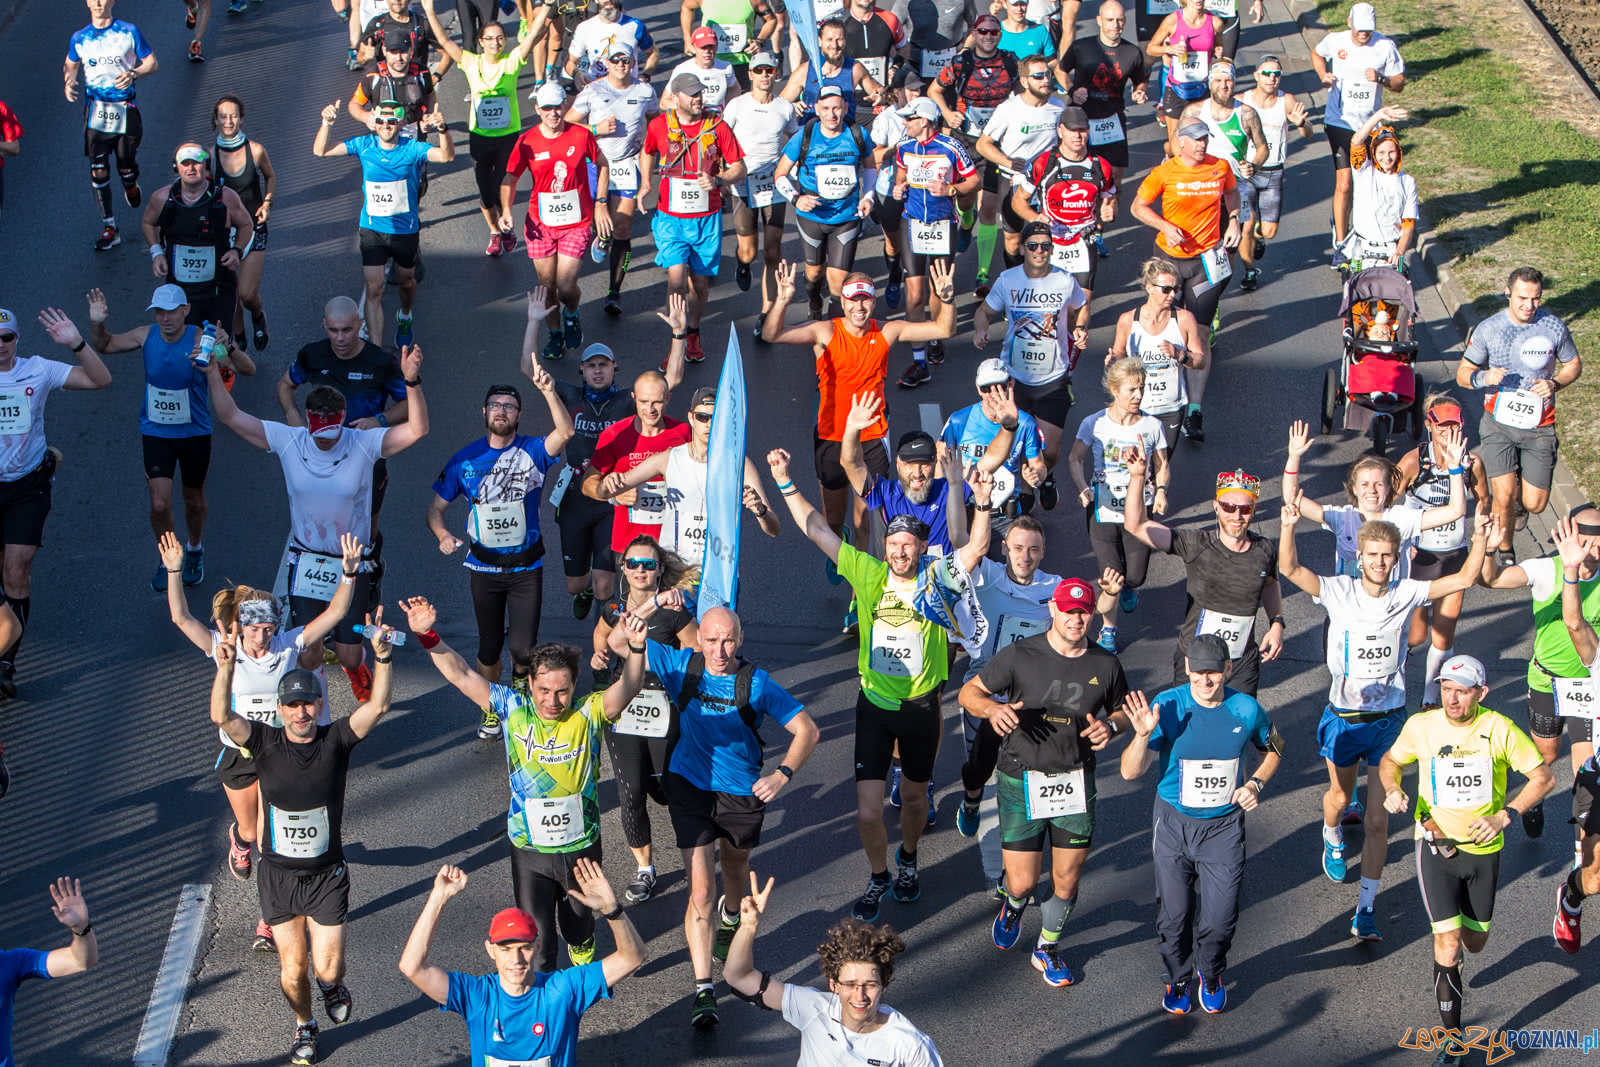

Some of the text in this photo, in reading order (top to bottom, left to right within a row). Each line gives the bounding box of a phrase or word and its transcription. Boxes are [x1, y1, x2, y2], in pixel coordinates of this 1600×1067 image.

[1347, 90, 1370, 99] 3683
[97, 110, 121, 121] 5086
[481, 107, 504, 117] 5227
[824, 177, 850, 187] 4428
[371, 193, 394, 204] 1242
[680, 190, 701, 200] 855
[548, 203, 574, 213] 2656
[917, 231, 943, 241] 4545
[1058, 250, 1081, 260] 2613
[182, 258, 208, 269] 3937
[1009, 288, 1064, 305] Wikoss
[1021, 351, 1046, 361] 1810
[0, 406, 21, 417] 113
[153, 400, 181, 412] 2081
[1506, 400, 1536, 415] 4375
[486, 517, 519, 530] 3564
[304, 568, 337, 584] 4452
[881, 646, 912, 659] 1762
[1357, 645, 1392, 659] 2630
[246, 710, 277, 722] 5271
[626, 703, 661, 718] 4570
[1194, 776, 1227, 789] 5195
[1445, 774, 1482, 789] 4105
[1039, 782, 1074, 798] 2796
[540, 812, 571, 828] 405
[282, 825, 318, 840] 1730
